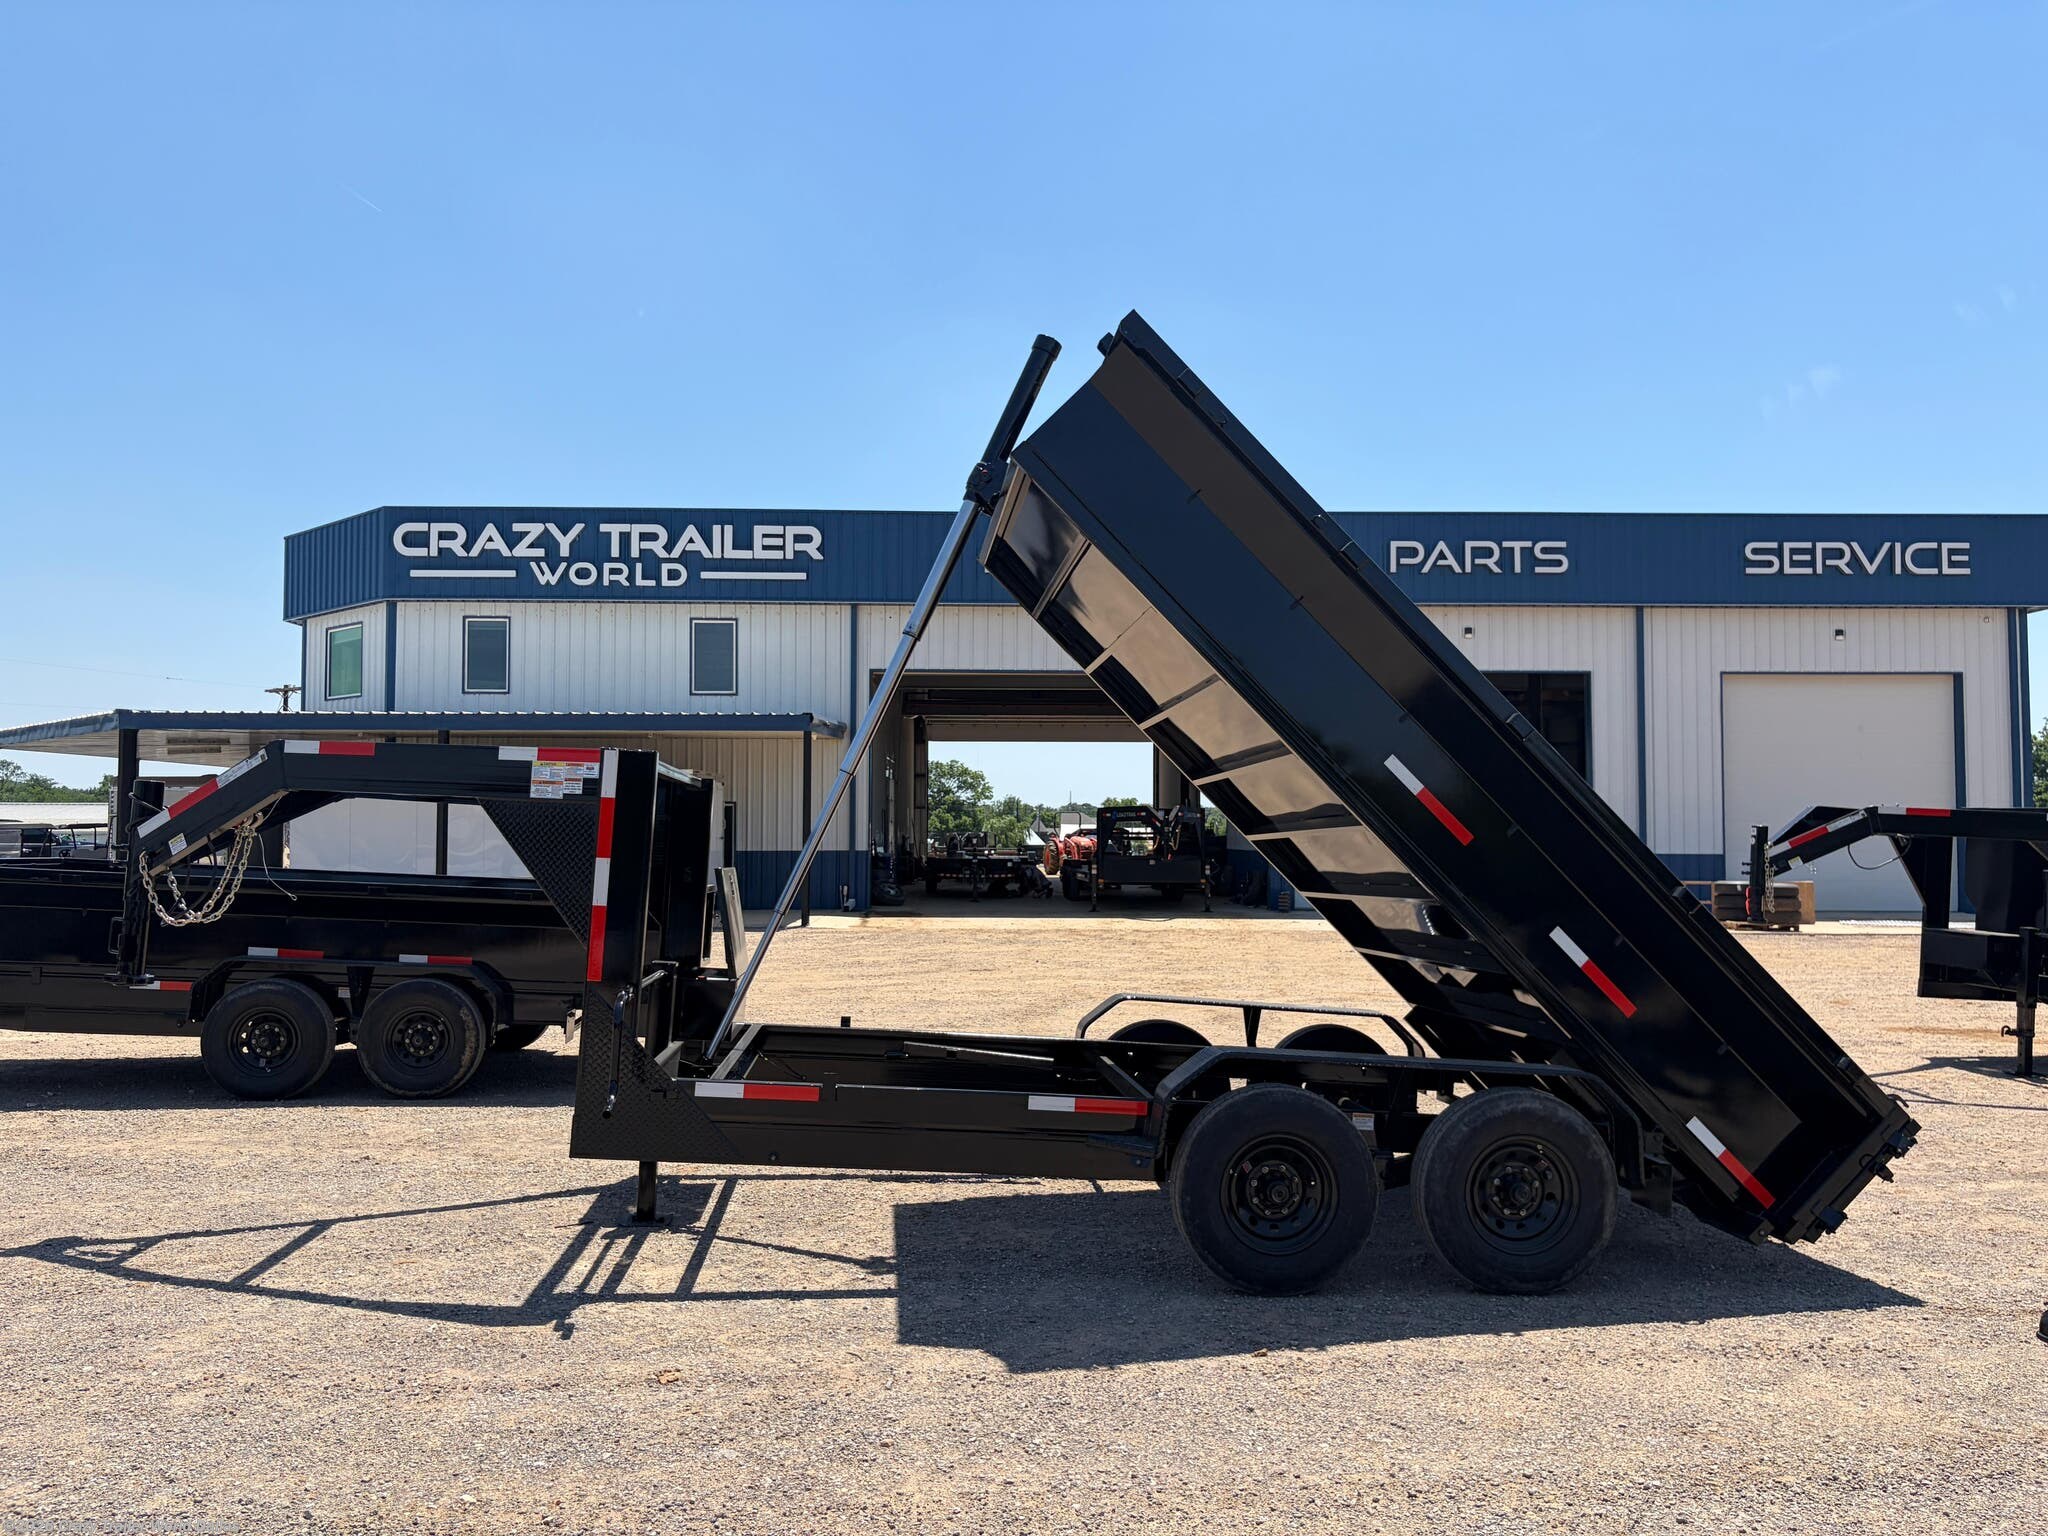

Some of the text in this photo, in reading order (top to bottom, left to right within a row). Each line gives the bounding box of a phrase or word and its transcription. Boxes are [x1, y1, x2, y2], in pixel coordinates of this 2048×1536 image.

[394, 523, 823, 559] CRAZY TRAILER
[1391, 541, 1568, 572] PARTS
[1745, 542, 1970, 574] SERVICE
[530, 562, 687, 586] WORLD
